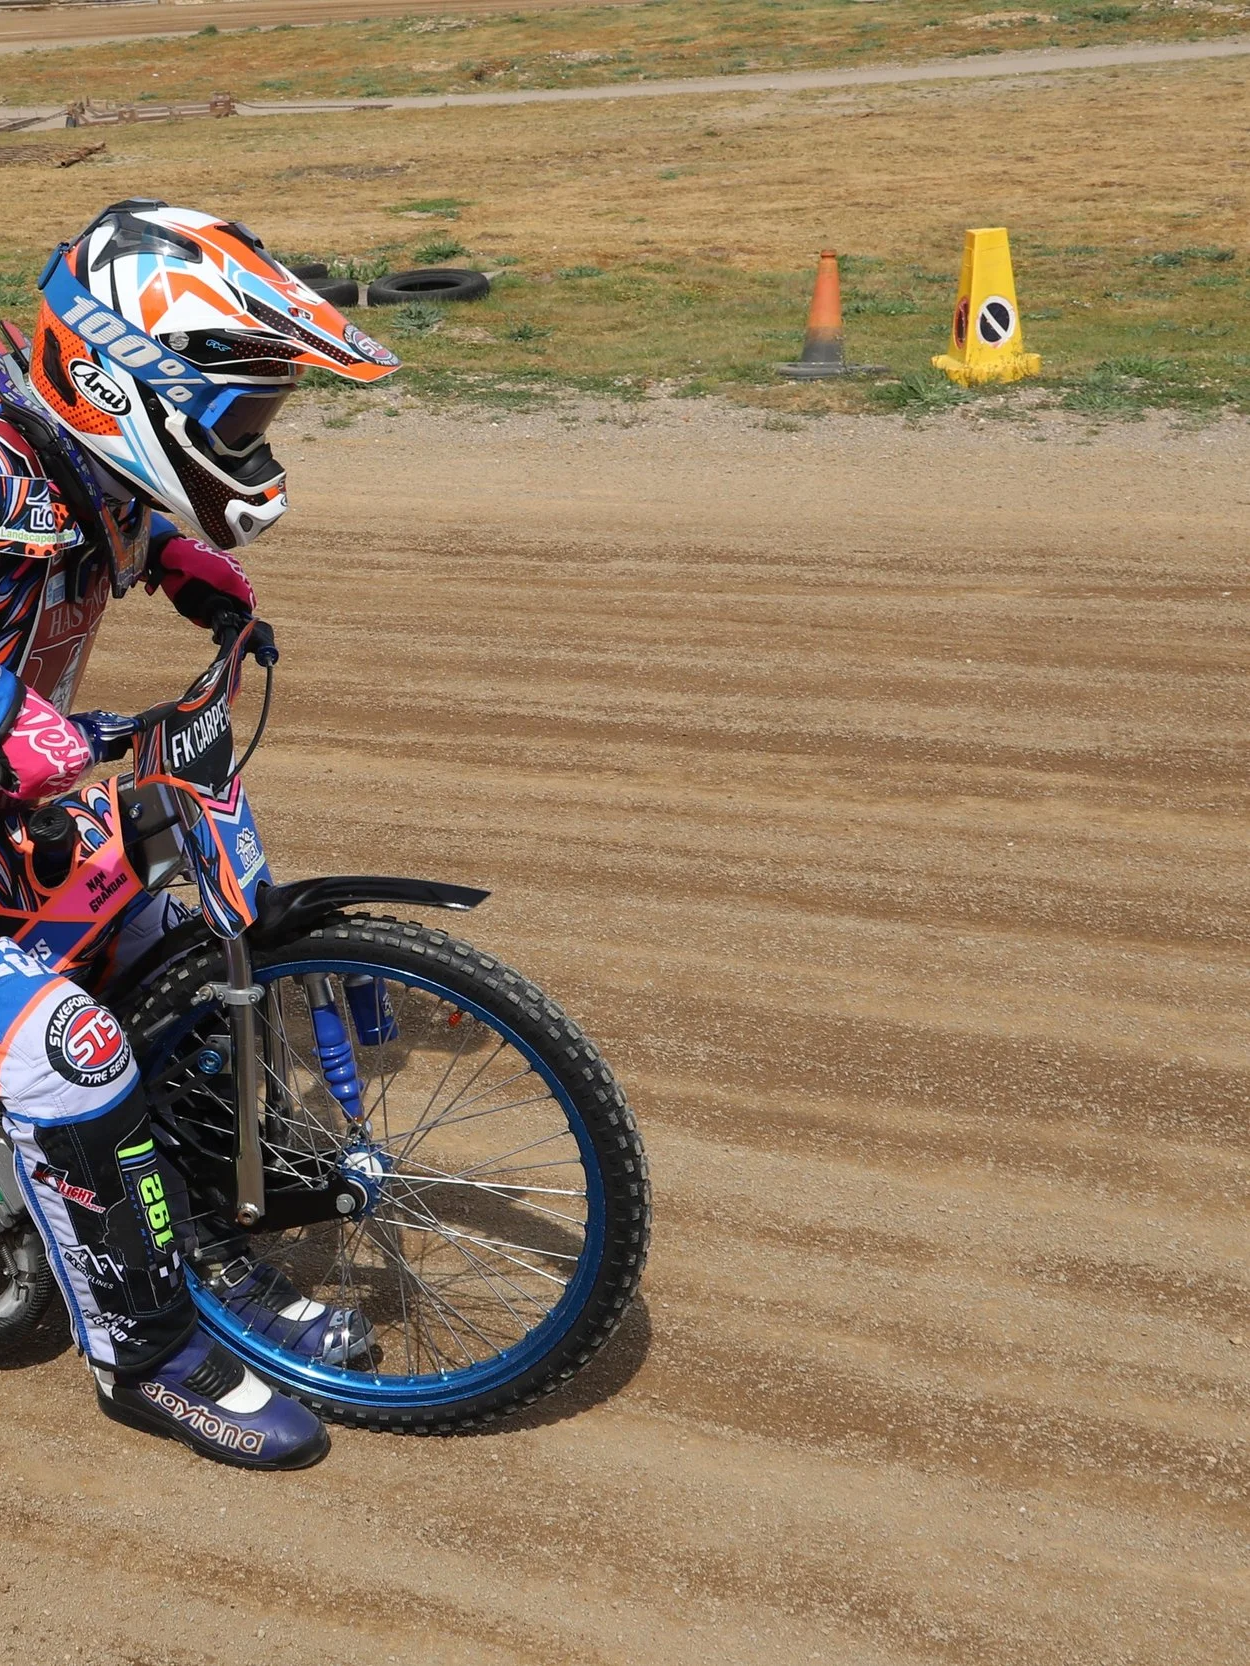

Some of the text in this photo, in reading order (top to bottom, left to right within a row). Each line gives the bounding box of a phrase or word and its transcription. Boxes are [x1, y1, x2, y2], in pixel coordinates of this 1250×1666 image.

[61, 295, 206, 403] 100%
[72, 371, 127, 409] Arai
[171, 730, 197, 769] FK
[85, 870, 107, 893] NAN
[89, 872, 128, 913] GRANDAD
[49, 995, 95, 1048] STAKEFORD
[67, 1010, 118, 1068] STS
[80, 1073, 108, 1084] TYRE
[139, 1172, 174, 1250] 192
[140, 1382, 267, 1456] daytona
